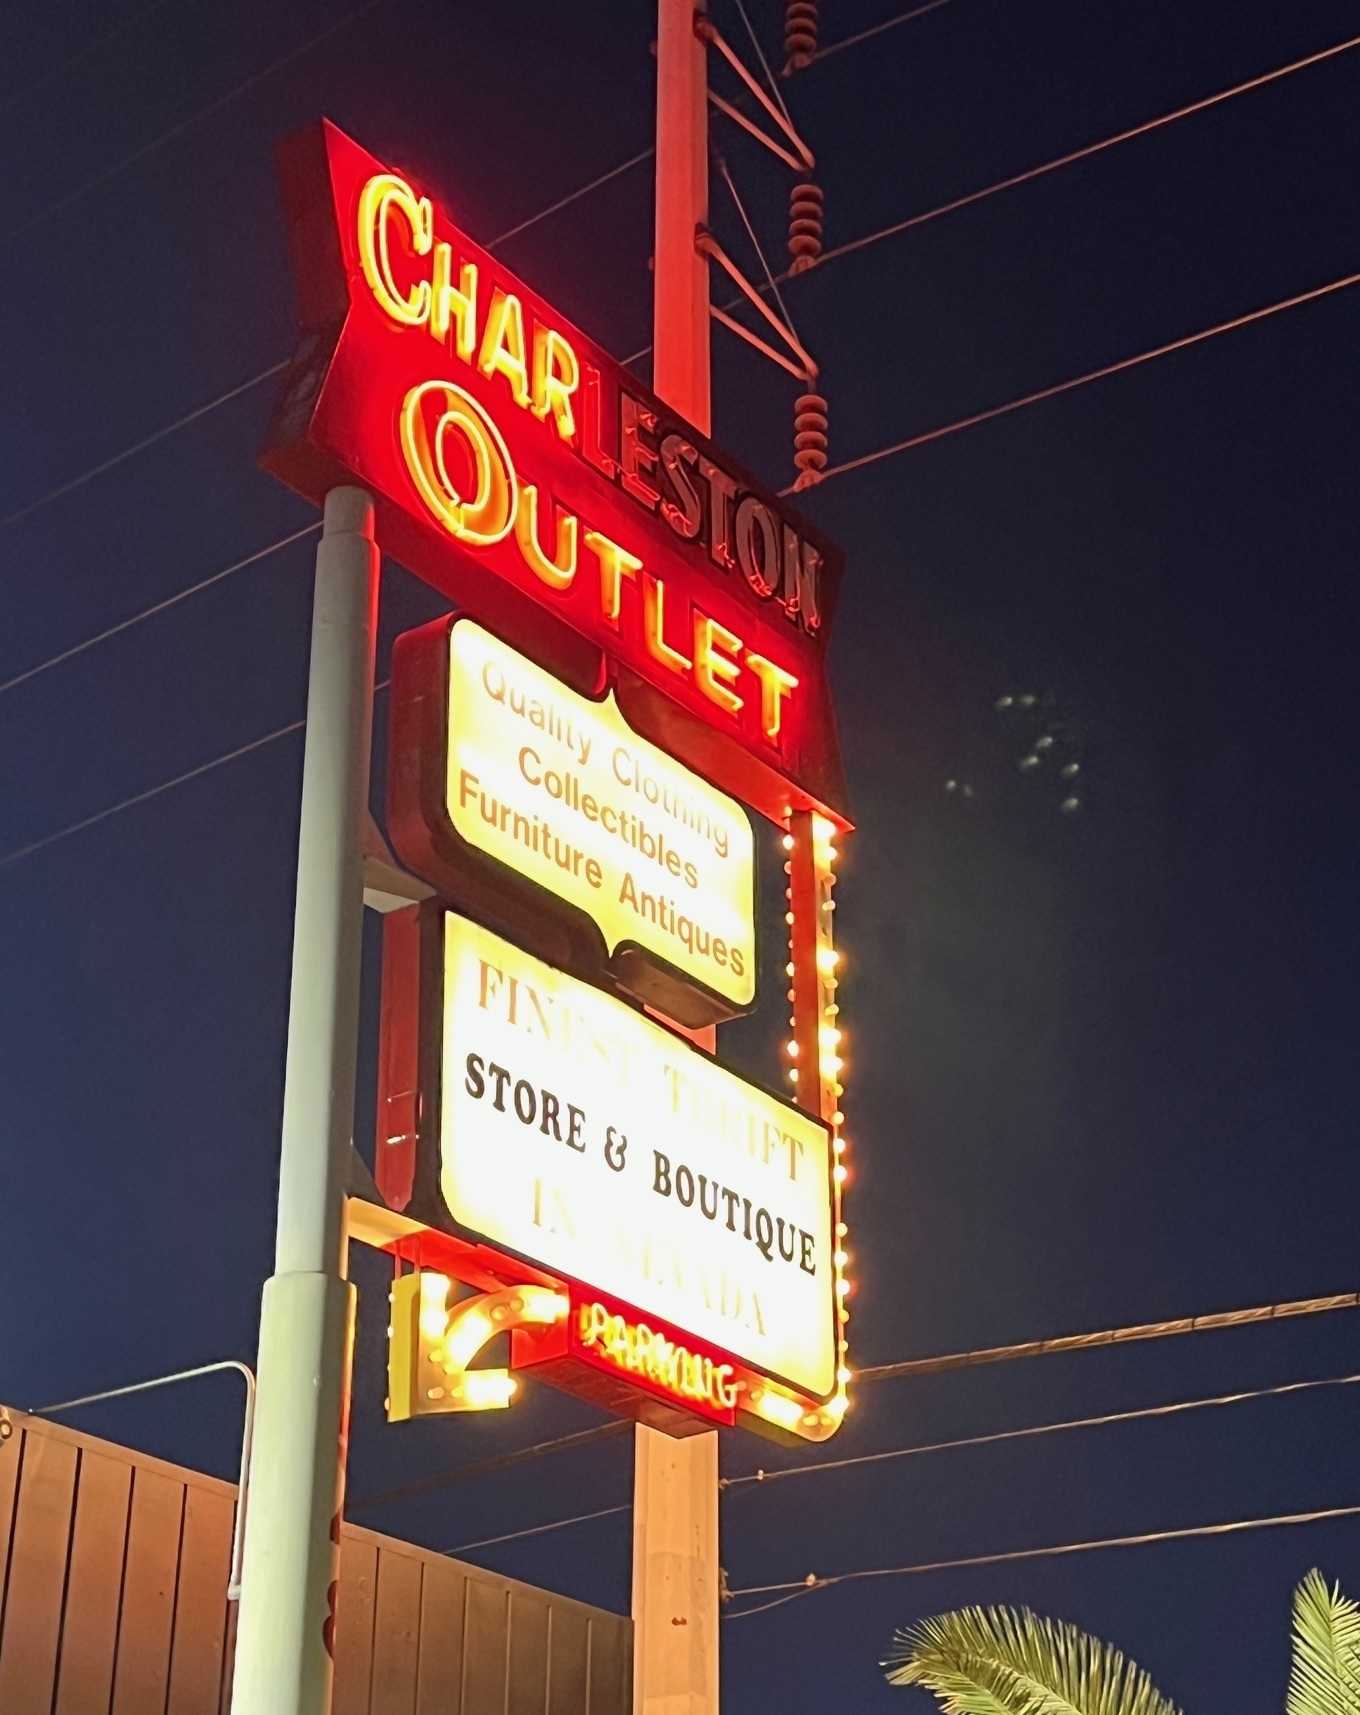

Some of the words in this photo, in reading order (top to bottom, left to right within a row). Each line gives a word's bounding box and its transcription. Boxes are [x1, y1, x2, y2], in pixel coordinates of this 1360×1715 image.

[356, 172, 824, 638] CHARLESTON
[399, 378, 800, 750] OUTLET
[482, 661, 591, 765] Quality
[612, 747, 729, 858] Clothing
[519, 747, 698, 889] Collectibles
[460, 768, 602, 888] Furniture
[619, 872, 744, 977] Antiques
[464, 1052, 587, 1154] STORE
[604, 1126, 628, 1172] &
[652, 1149, 817, 1276] BOUTIQUE
[581, 1302, 738, 1410] PARKING
